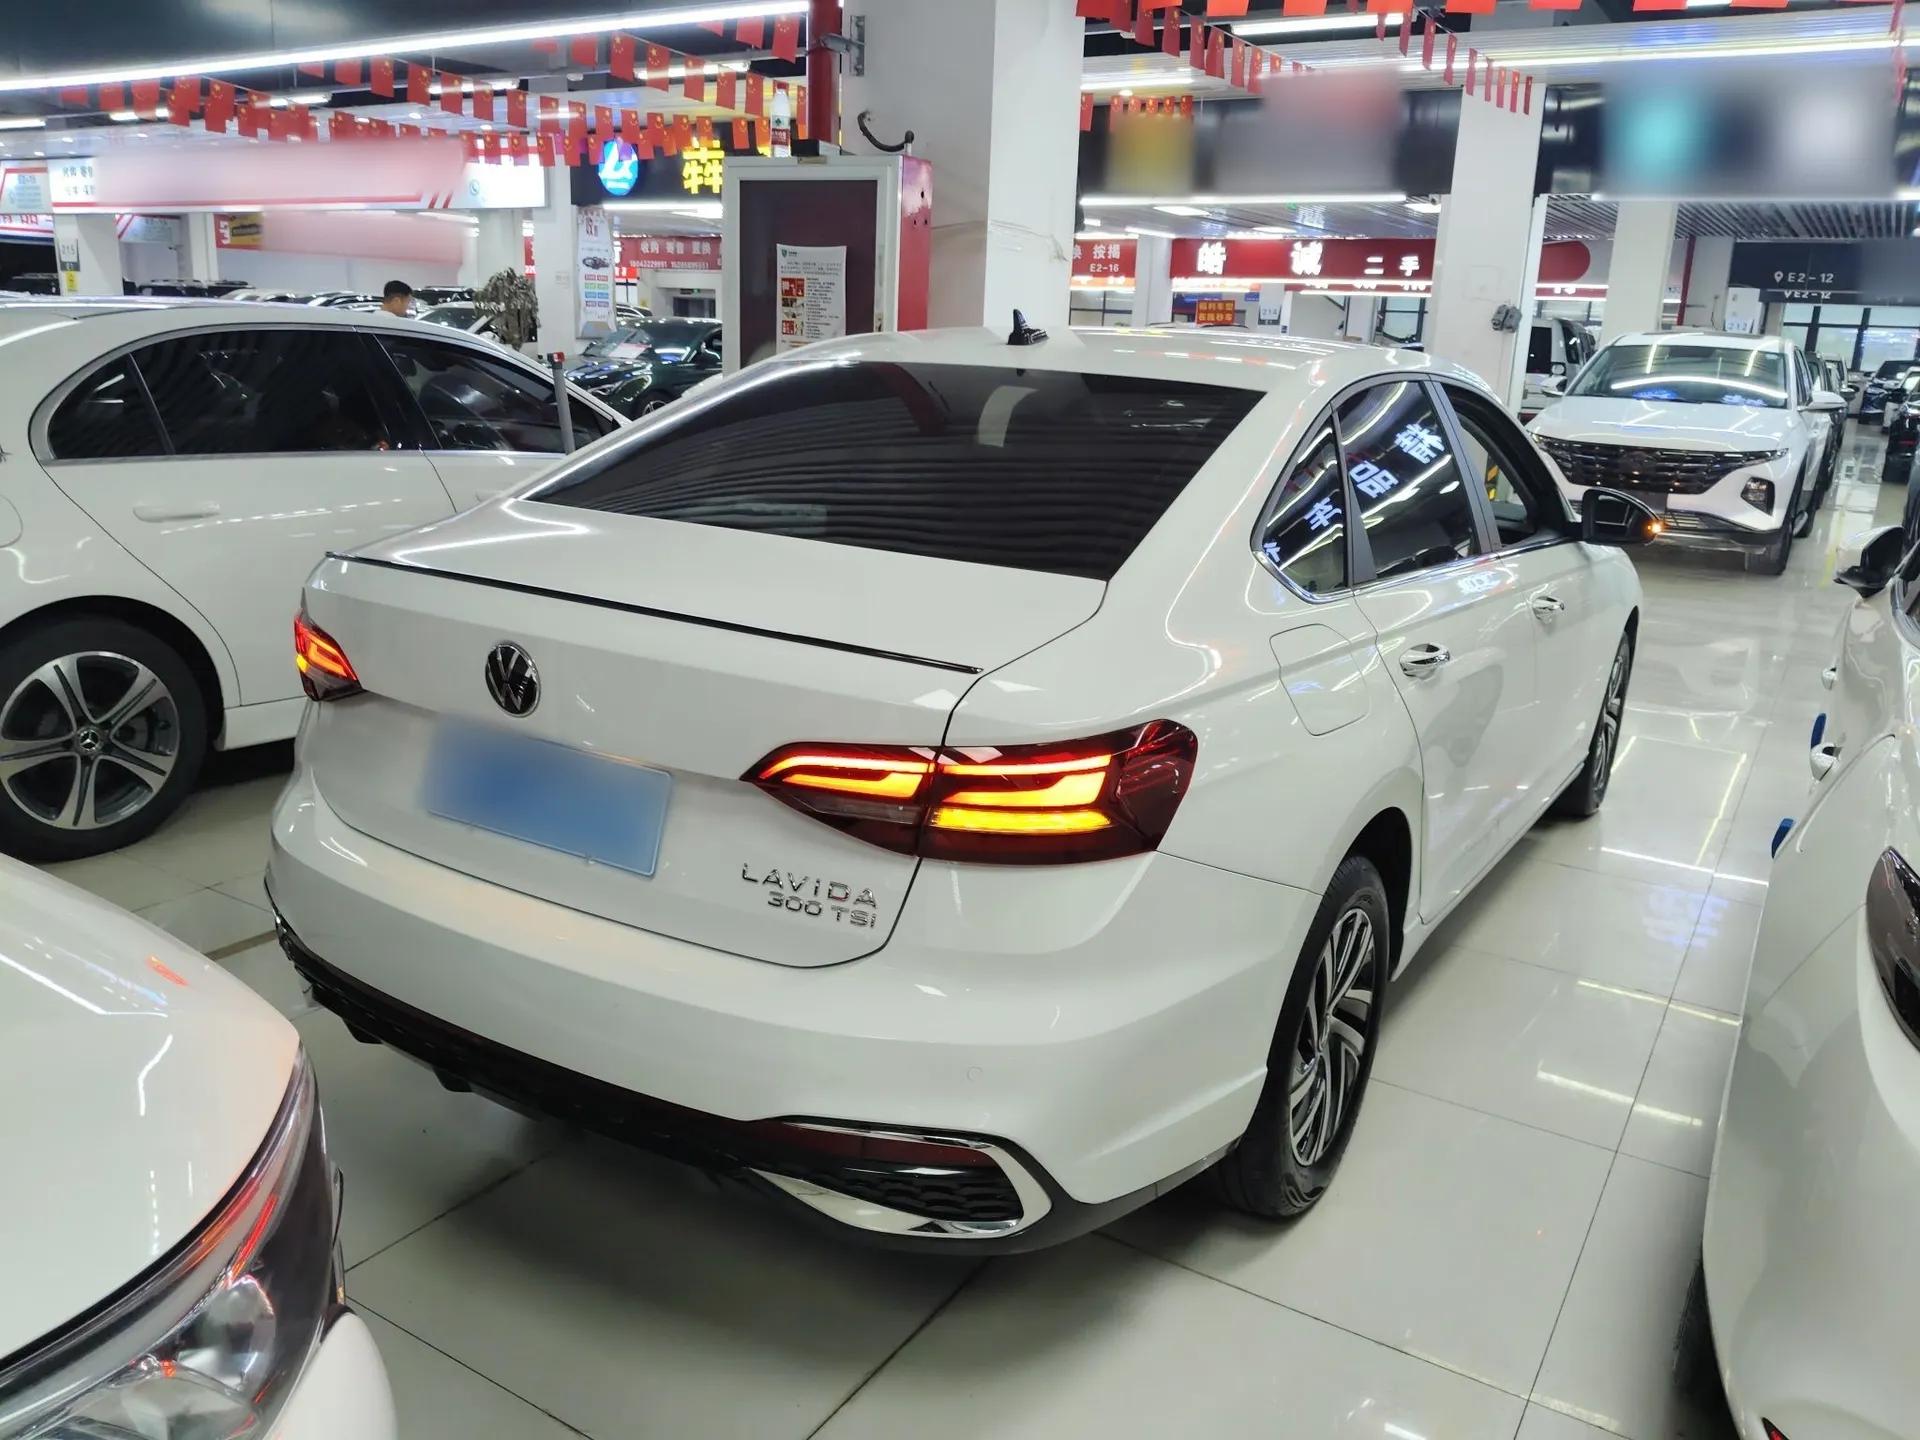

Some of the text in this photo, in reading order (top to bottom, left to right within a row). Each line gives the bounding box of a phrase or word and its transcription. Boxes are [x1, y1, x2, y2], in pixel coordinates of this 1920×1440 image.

[1093, 244, 1120, 260] 按揭
[1787, 273, 1834, 284] E2-12
[742, 862, 877, 909] LAVIDA
[767, 891, 822, 916] 300
